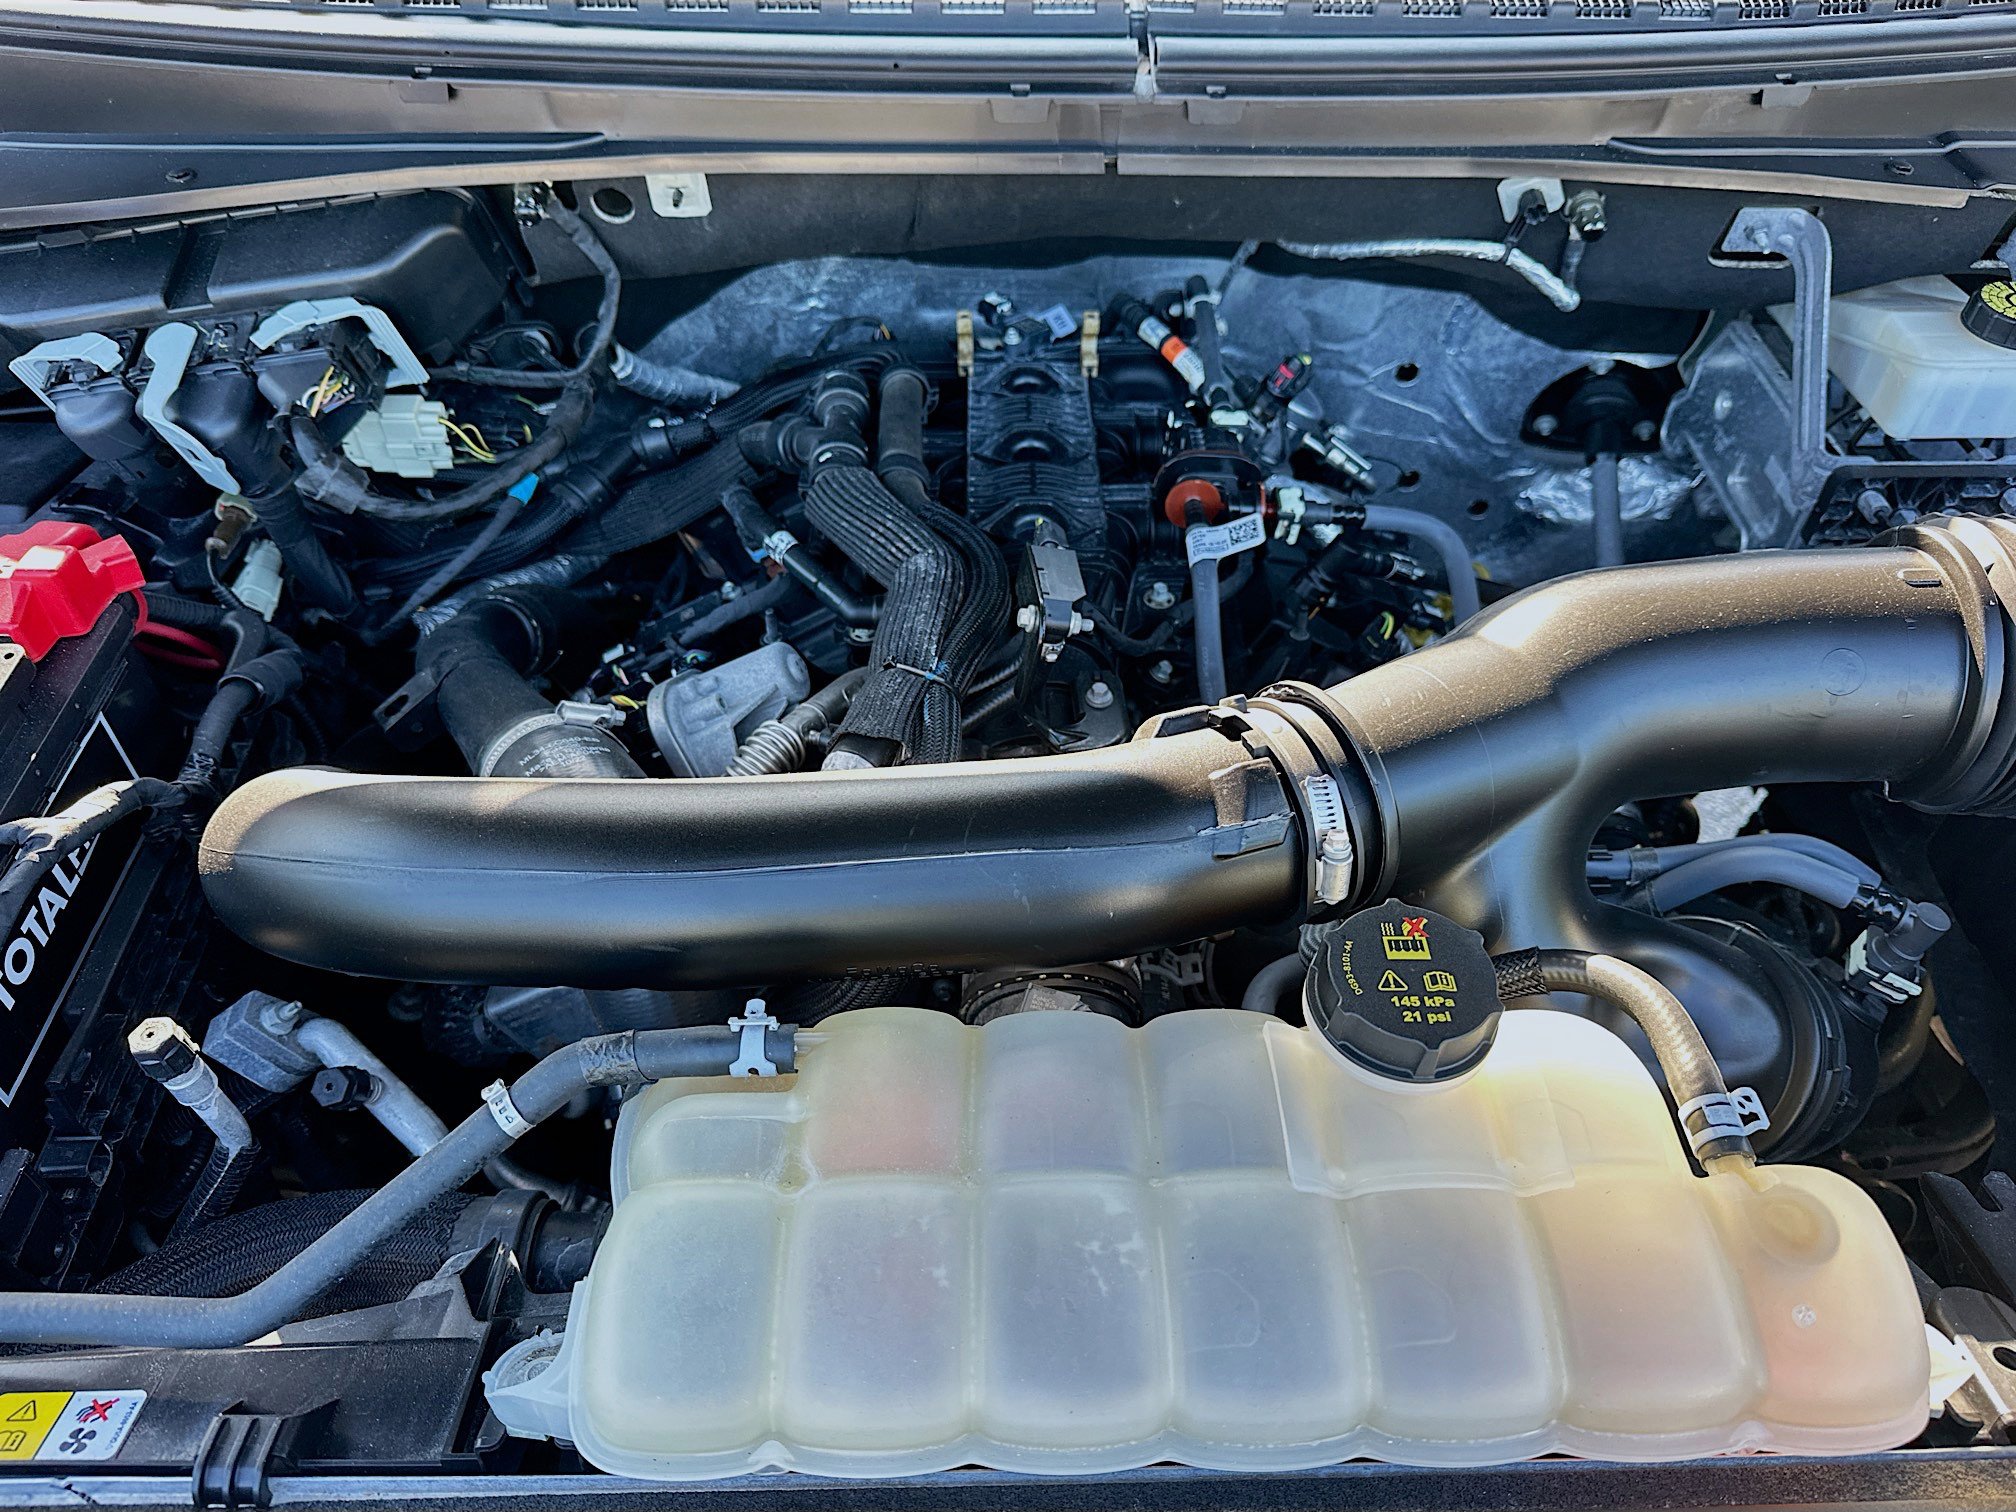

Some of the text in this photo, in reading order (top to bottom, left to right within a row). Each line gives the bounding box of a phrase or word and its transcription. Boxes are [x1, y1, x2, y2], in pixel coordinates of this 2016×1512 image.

[1341, 940, 1364, 996] DG93-8101-AA
[1391, 996, 1455, 1007] 145 kPa
[1403, 1011, 1452, 1025] 21 psi
